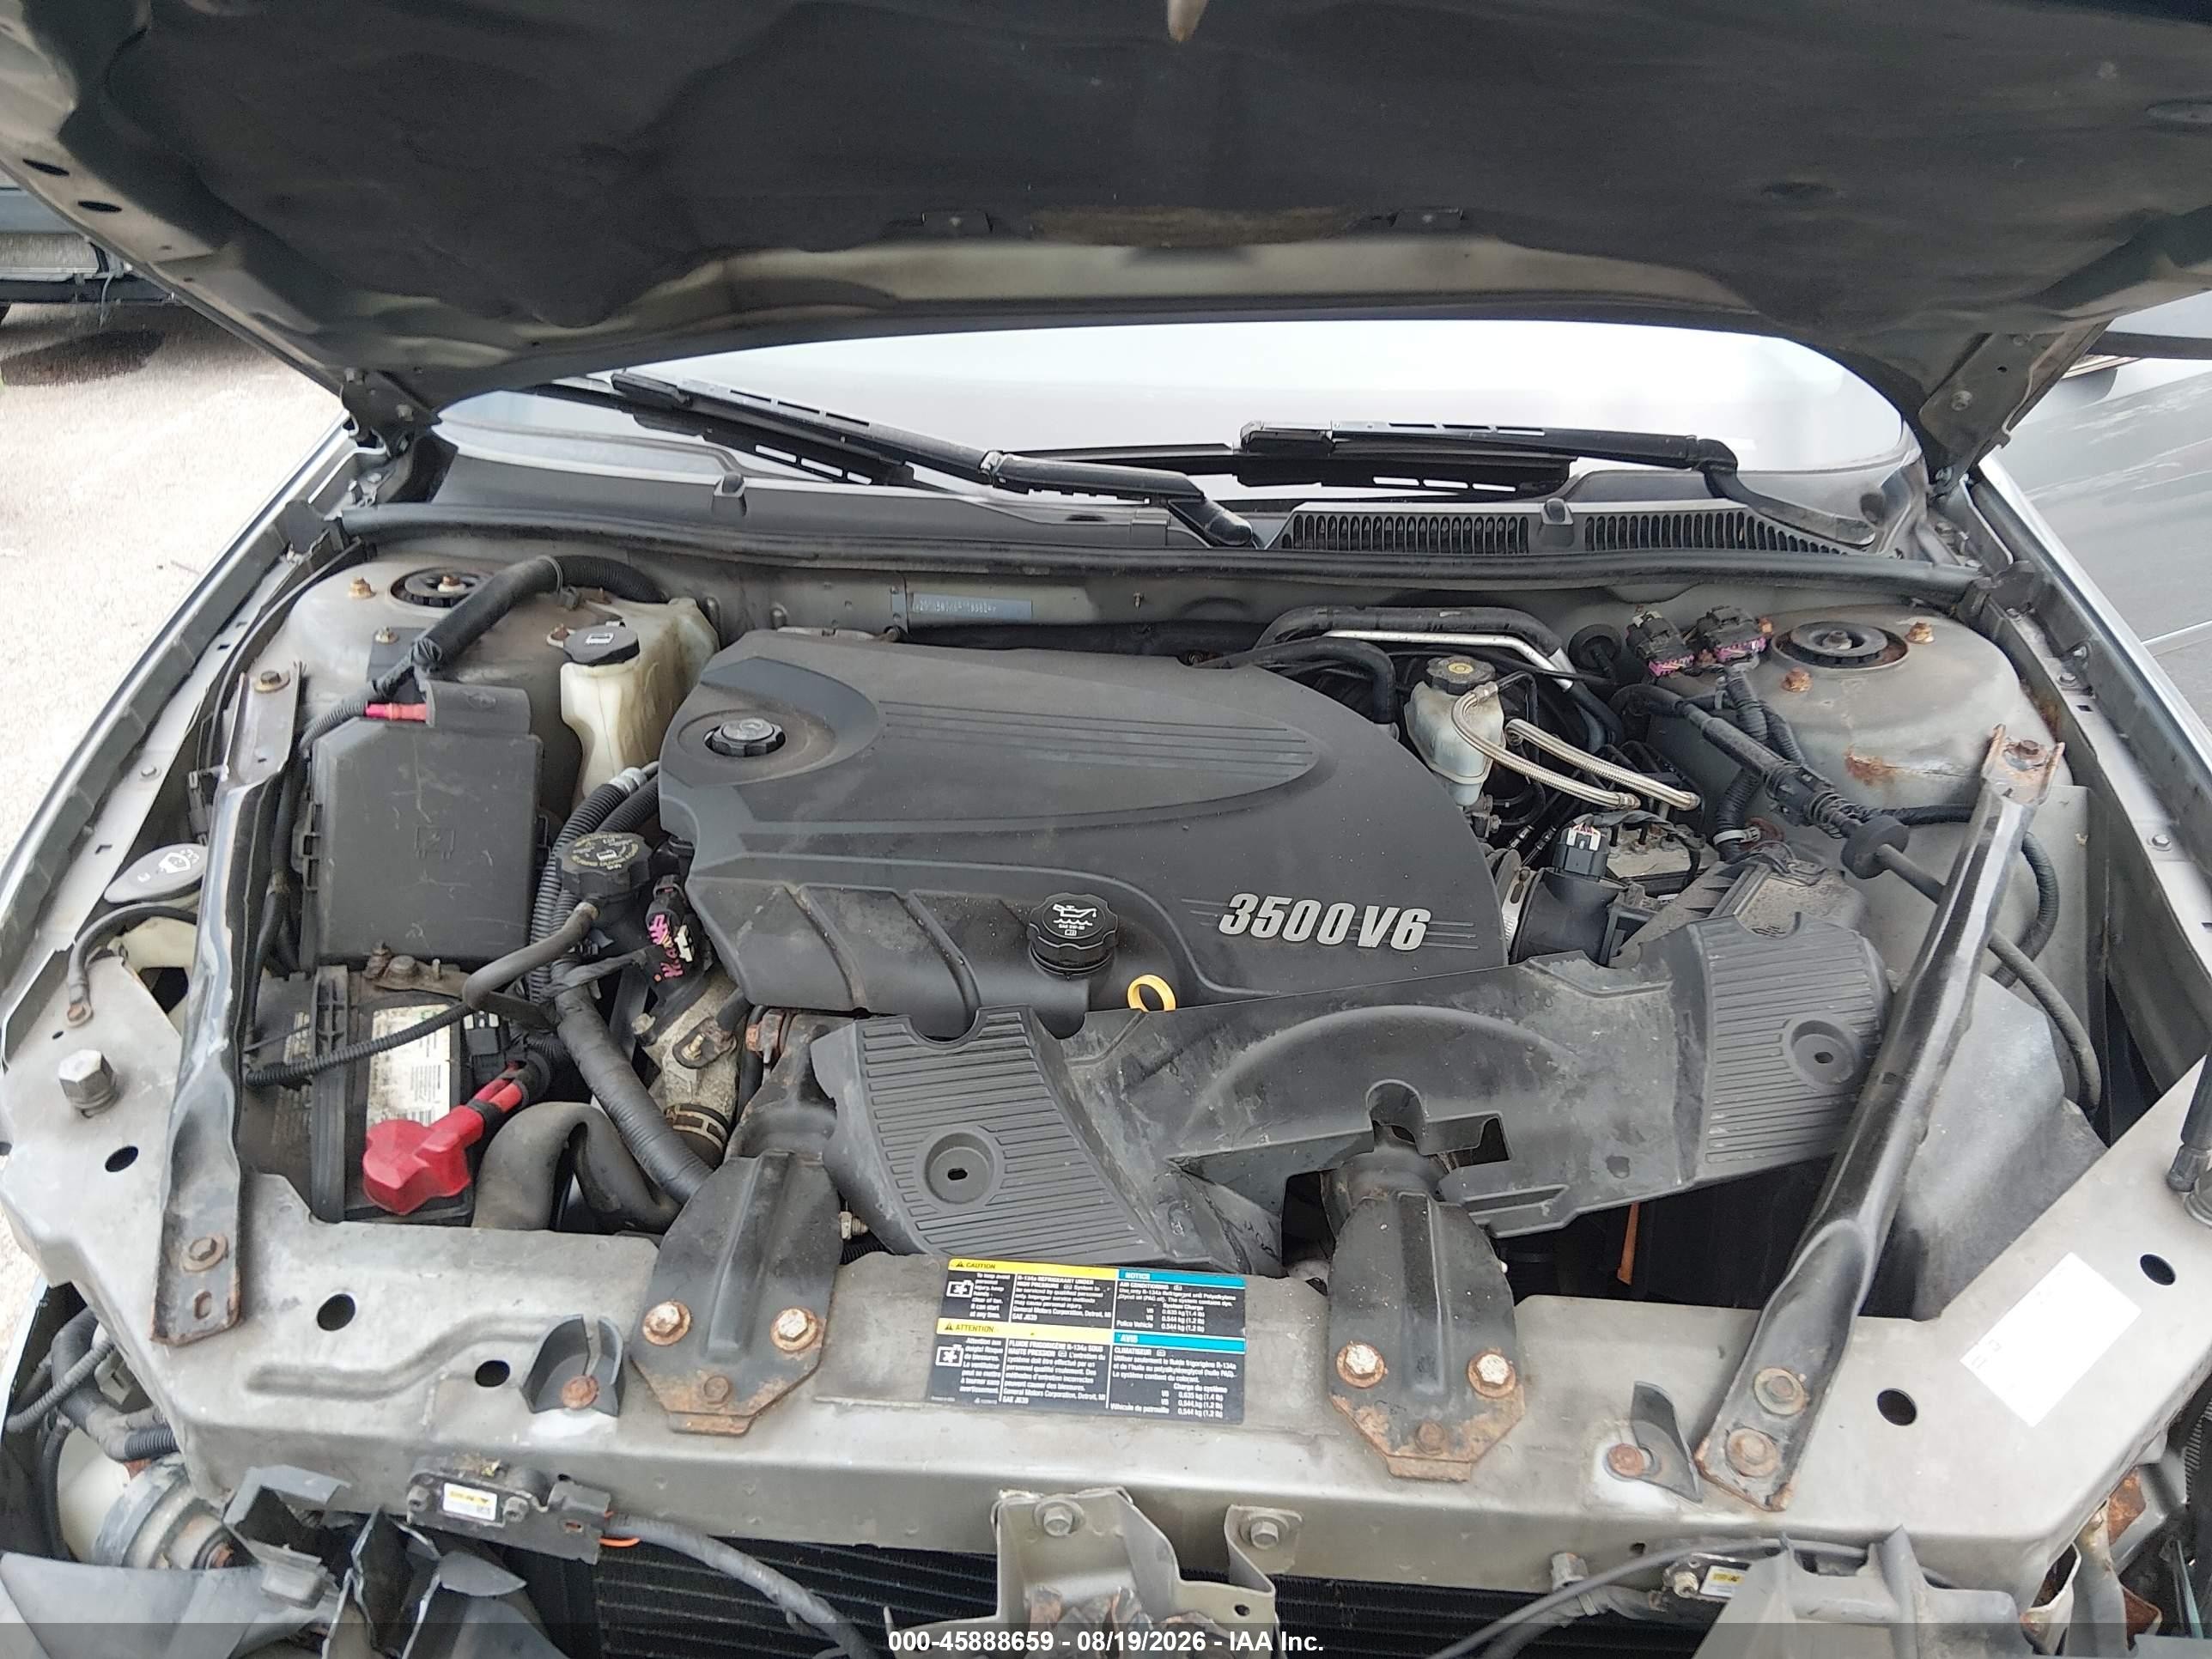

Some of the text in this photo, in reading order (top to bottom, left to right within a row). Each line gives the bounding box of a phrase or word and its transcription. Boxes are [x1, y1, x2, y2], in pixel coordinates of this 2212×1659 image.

[1218, 892, 1431, 951] 3500 V6
[956, 1324, 994, 1333] ATTENTION
[1121, 1334, 1138, 1343] AVIS
